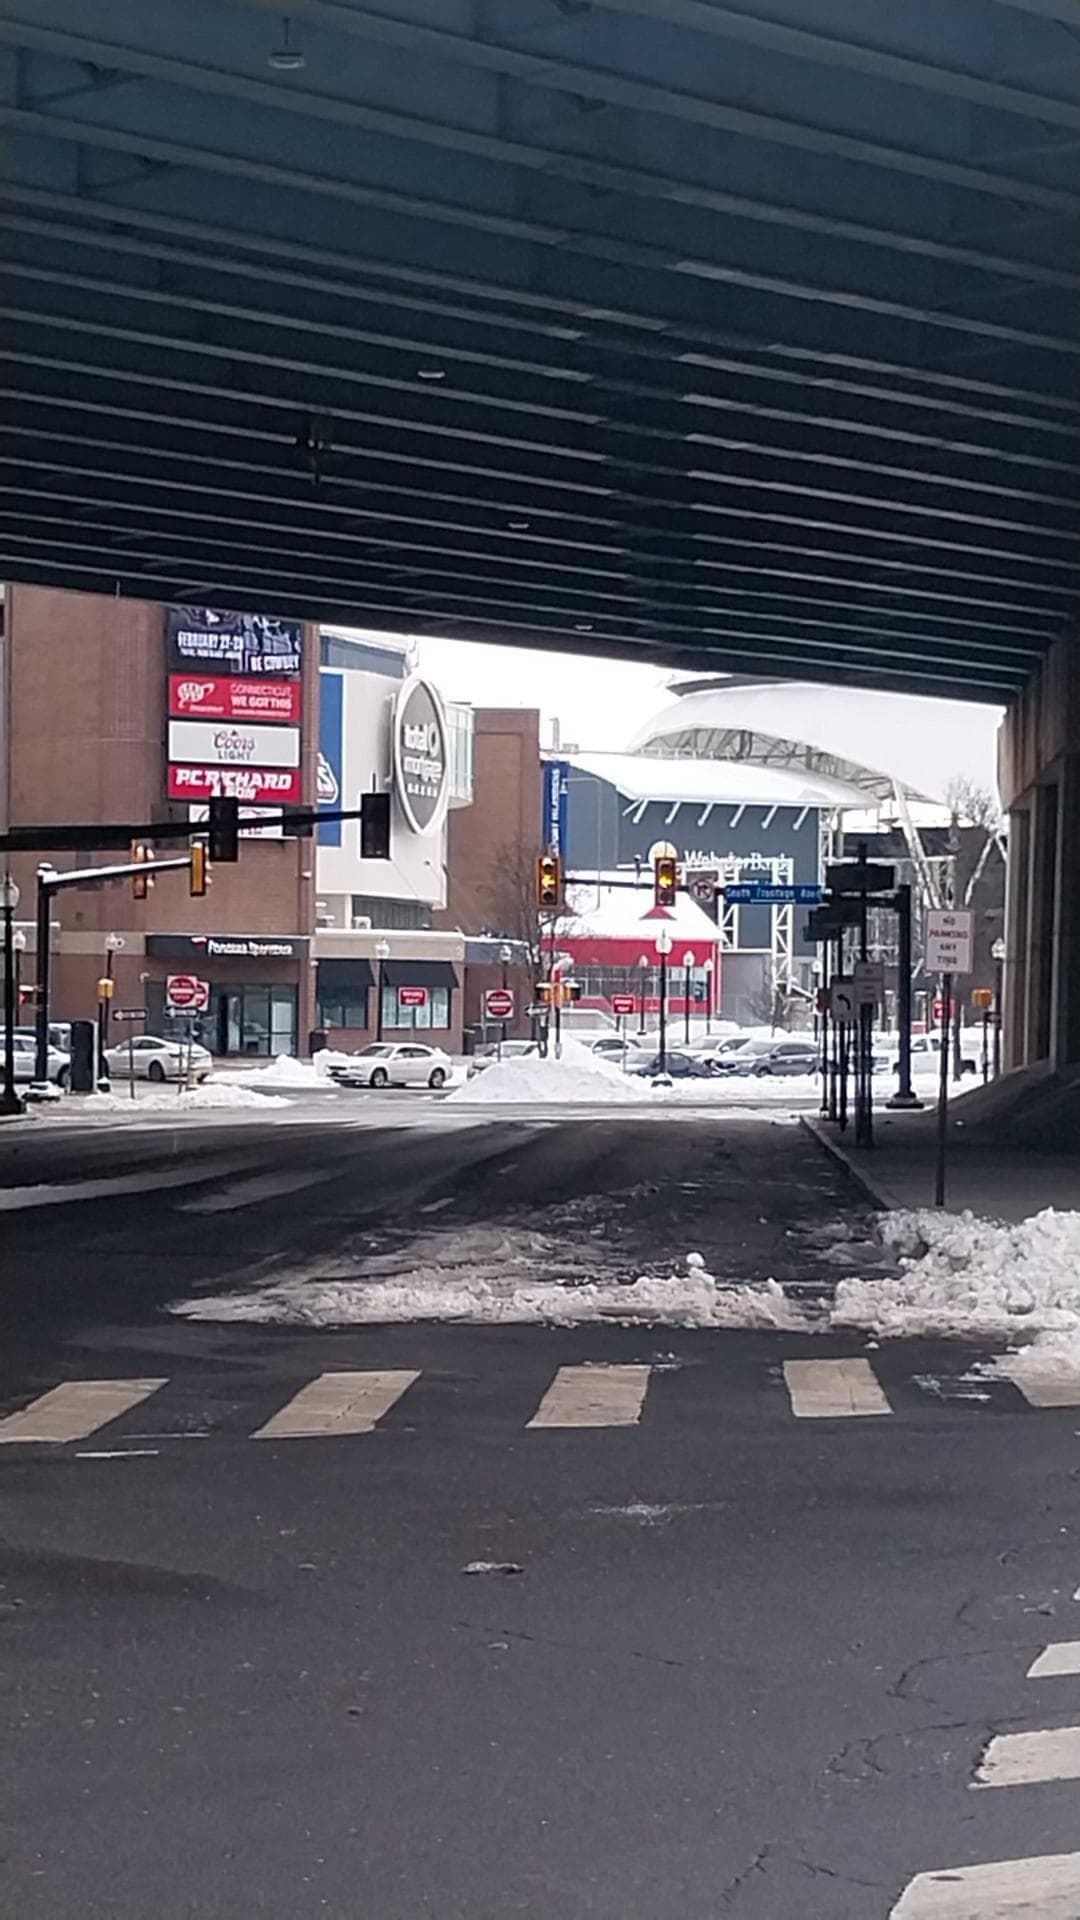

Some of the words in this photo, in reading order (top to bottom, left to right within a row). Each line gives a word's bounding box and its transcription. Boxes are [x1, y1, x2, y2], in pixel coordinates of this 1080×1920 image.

[231, 695, 247, 707] WE
[248, 697, 269, 708] GOT
[270, 697, 292, 710] THIS
[213, 731, 255, 751] Coors
[218, 750, 251, 761] LIGHT
[204, 770, 292, 791] RICHARD
[942, 916, 956, 926] NO
[929, 929, 969, 940] PARKING
